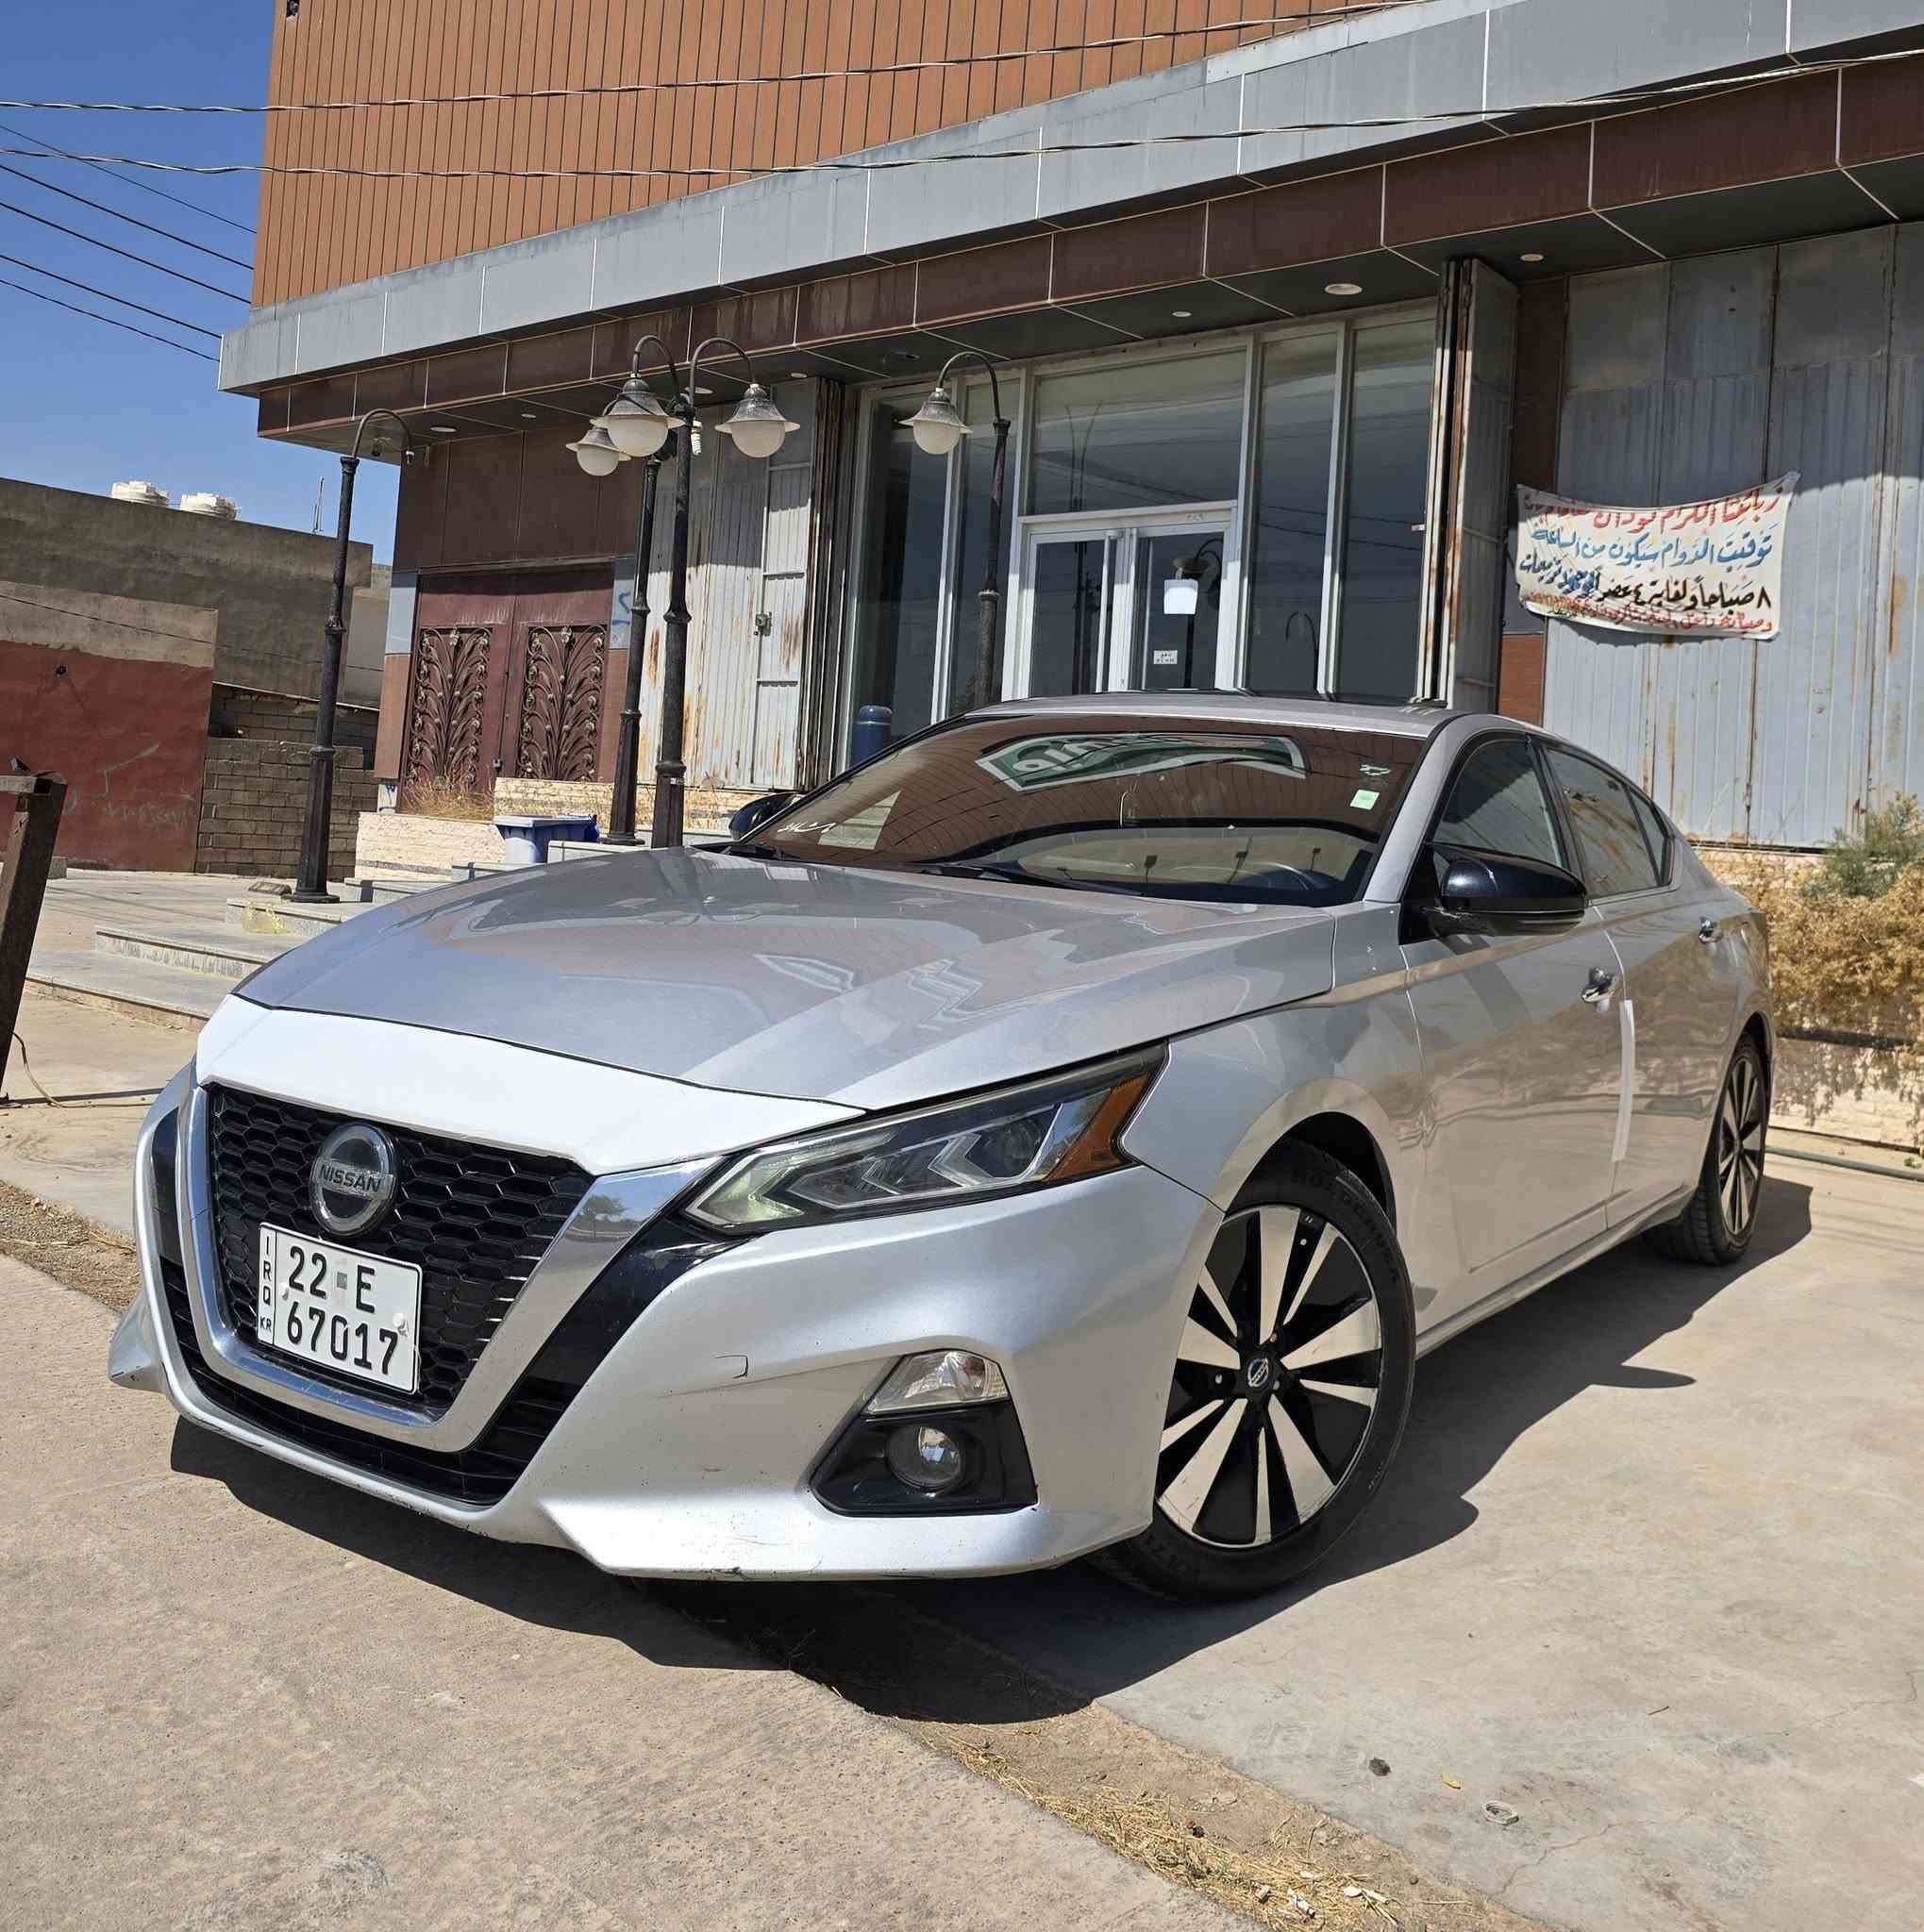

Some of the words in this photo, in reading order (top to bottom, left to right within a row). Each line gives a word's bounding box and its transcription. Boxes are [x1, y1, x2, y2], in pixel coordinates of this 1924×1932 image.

[1581, 539, 1606, 559] من
[1608, 531, 1659, 569] سيكون
[1661, 534, 1714, 570] الدوام
[1716, 528, 1773, 573] توقيت
[1633, 583, 1645, 607] ٤
[1756, 586, 1772, 609] ٨
[320, 1164, 379, 1193] NISSAN
[262, 1236, 273, 1306] IRQ
[287, 1245, 328, 1299] 22
[355, 1264, 376, 1314] E
[259, 1315, 273, 1333] KR
[287, 1301, 399, 1375] 67017
